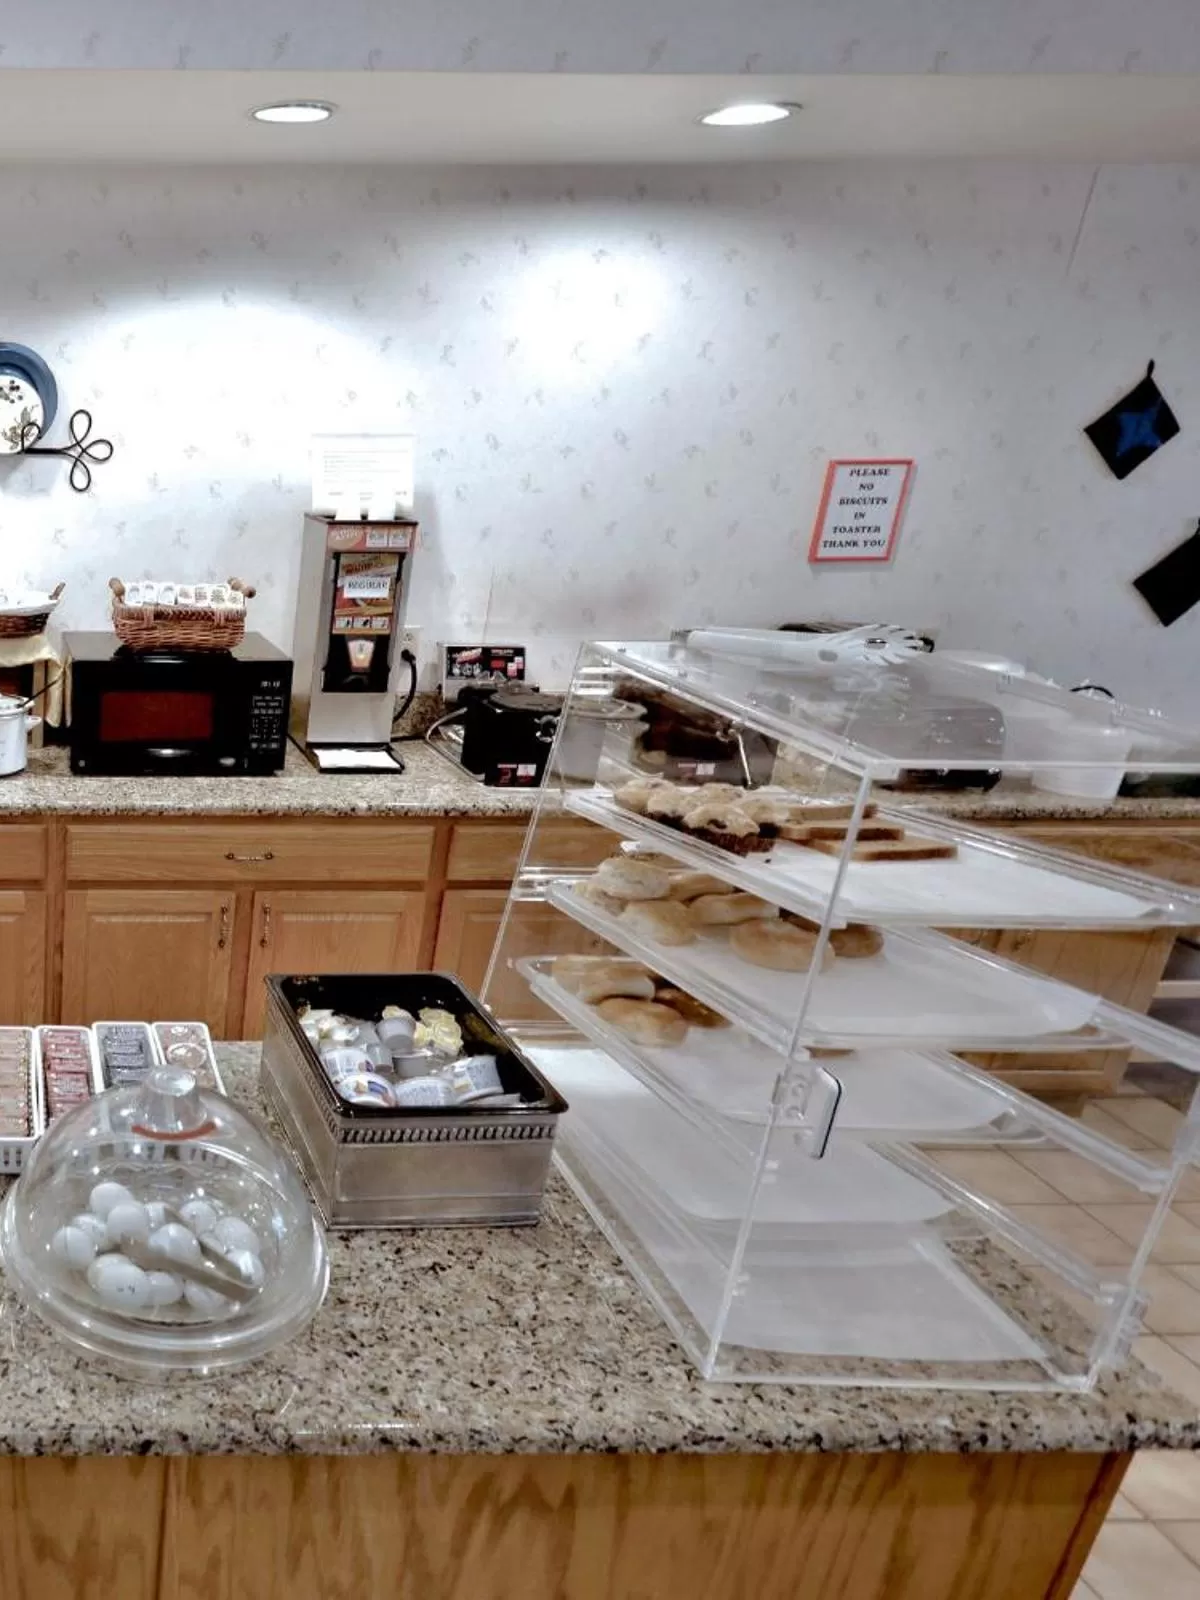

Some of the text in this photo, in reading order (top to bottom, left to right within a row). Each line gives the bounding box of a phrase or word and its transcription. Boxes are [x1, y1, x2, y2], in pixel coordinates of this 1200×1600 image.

[849, 467, 890, 477] PLEASE
[859, 482, 874, 491] NO
[838, 496, 889, 506] BISCUITS
[853, 511, 866, 520] IN
[832, 525, 881, 534] TOASTER
[822, 539, 886, 549] THANK YOU
